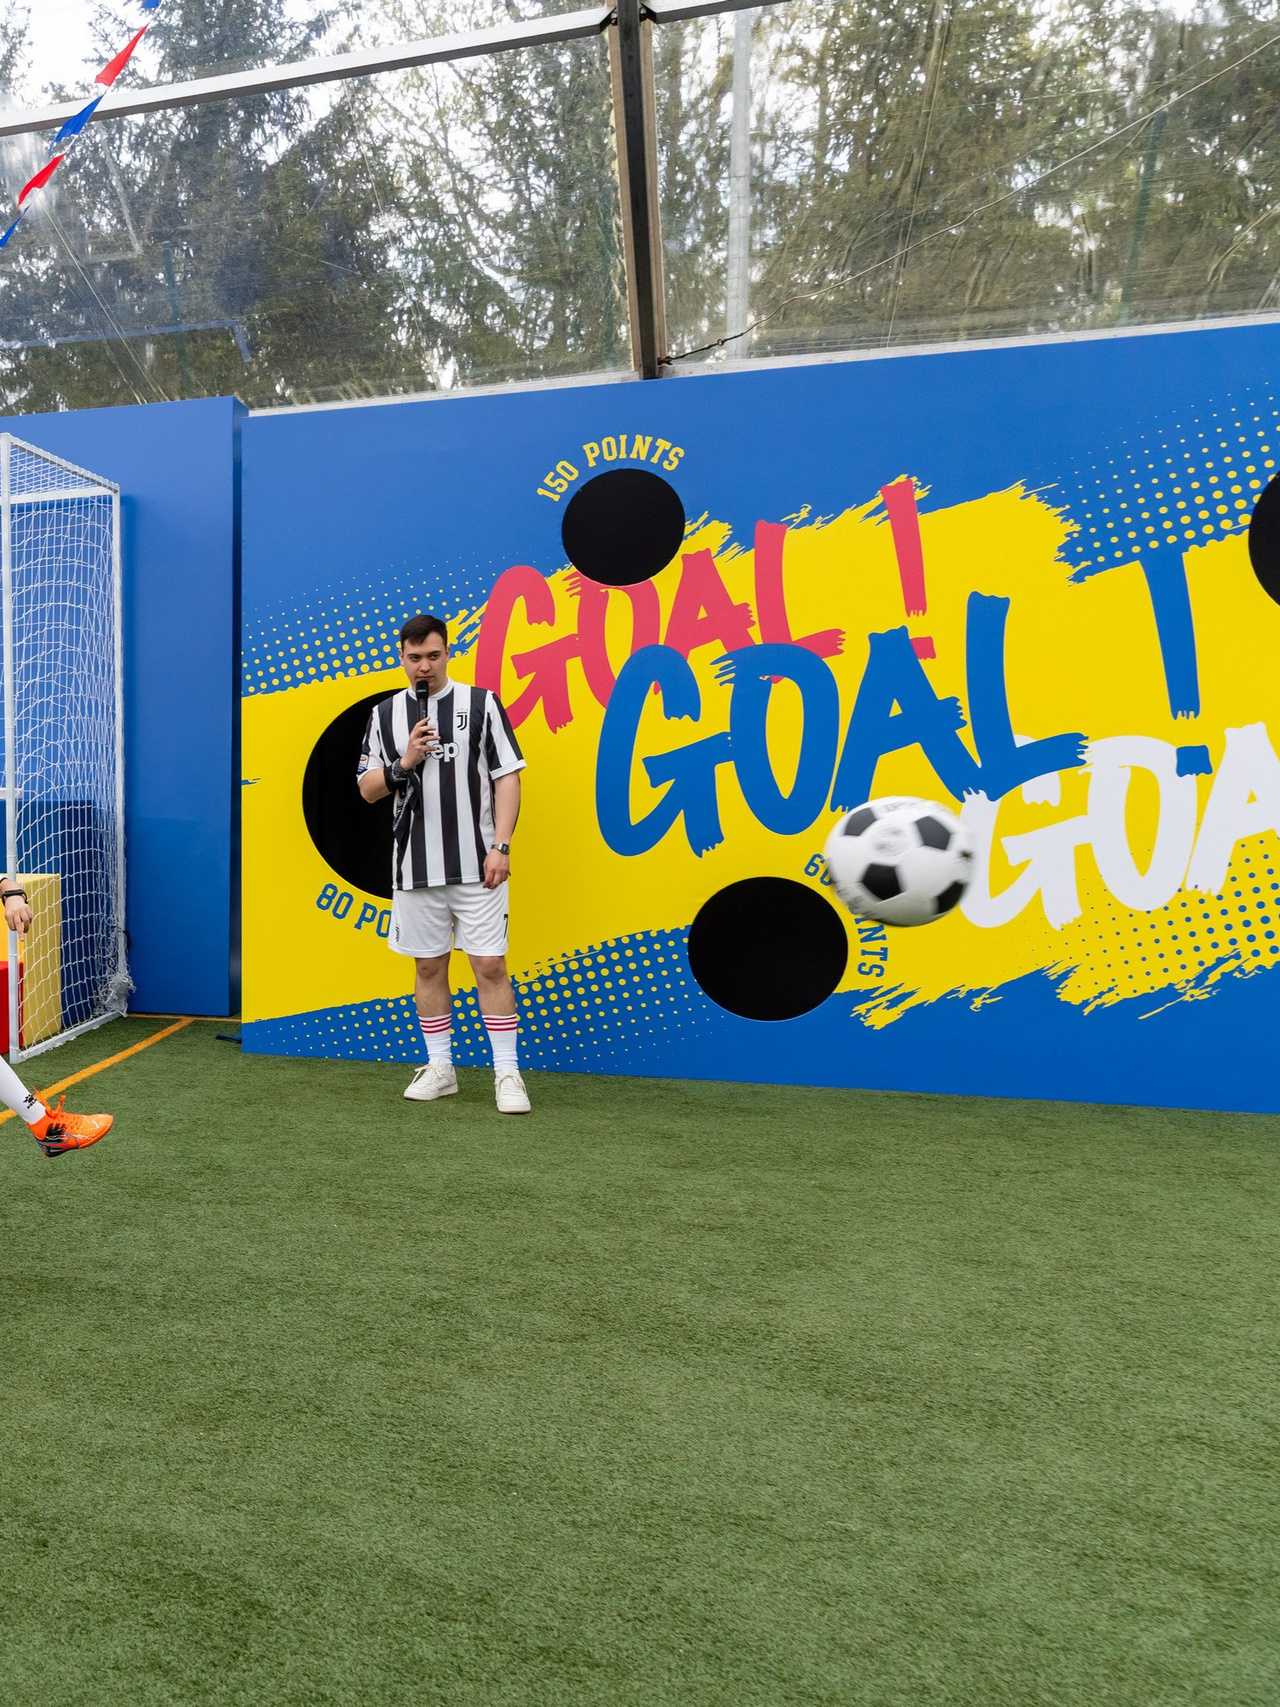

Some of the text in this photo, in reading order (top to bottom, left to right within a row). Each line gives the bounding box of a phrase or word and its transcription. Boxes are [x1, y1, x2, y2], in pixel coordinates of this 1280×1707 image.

[536, 434, 686, 502] 150 POINTS
[475, 519, 846, 735] GOAL
[423, 741, 460, 763] ep
[595, 590, 1090, 858] GOAL
[315, 882, 355, 921] 80
